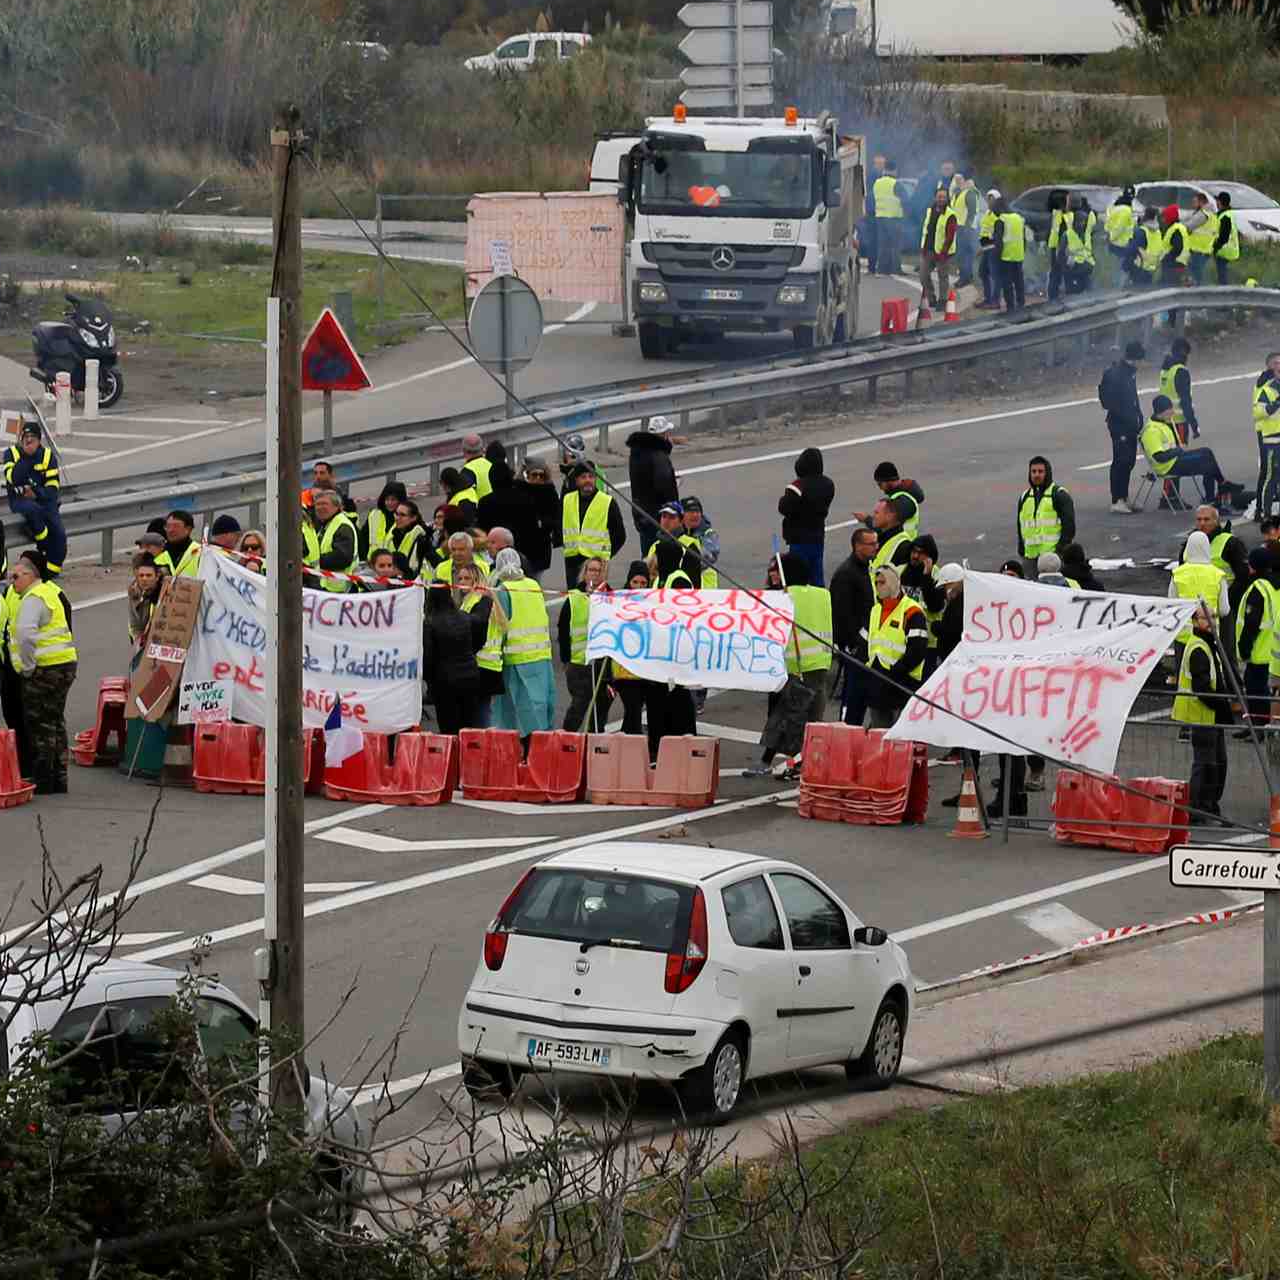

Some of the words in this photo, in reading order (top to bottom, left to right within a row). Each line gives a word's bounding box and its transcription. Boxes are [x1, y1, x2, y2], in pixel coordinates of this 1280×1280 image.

[303, 594, 396, 629] ACRON
[616, 602, 790, 645] SOYONS
[965, 601, 1056, 643] STOP
[589, 619, 786, 677] SOLIDAIRES
[961, 658, 1125, 721] SUFFIT
[1181, 858, 1268, 881] Carrefour
